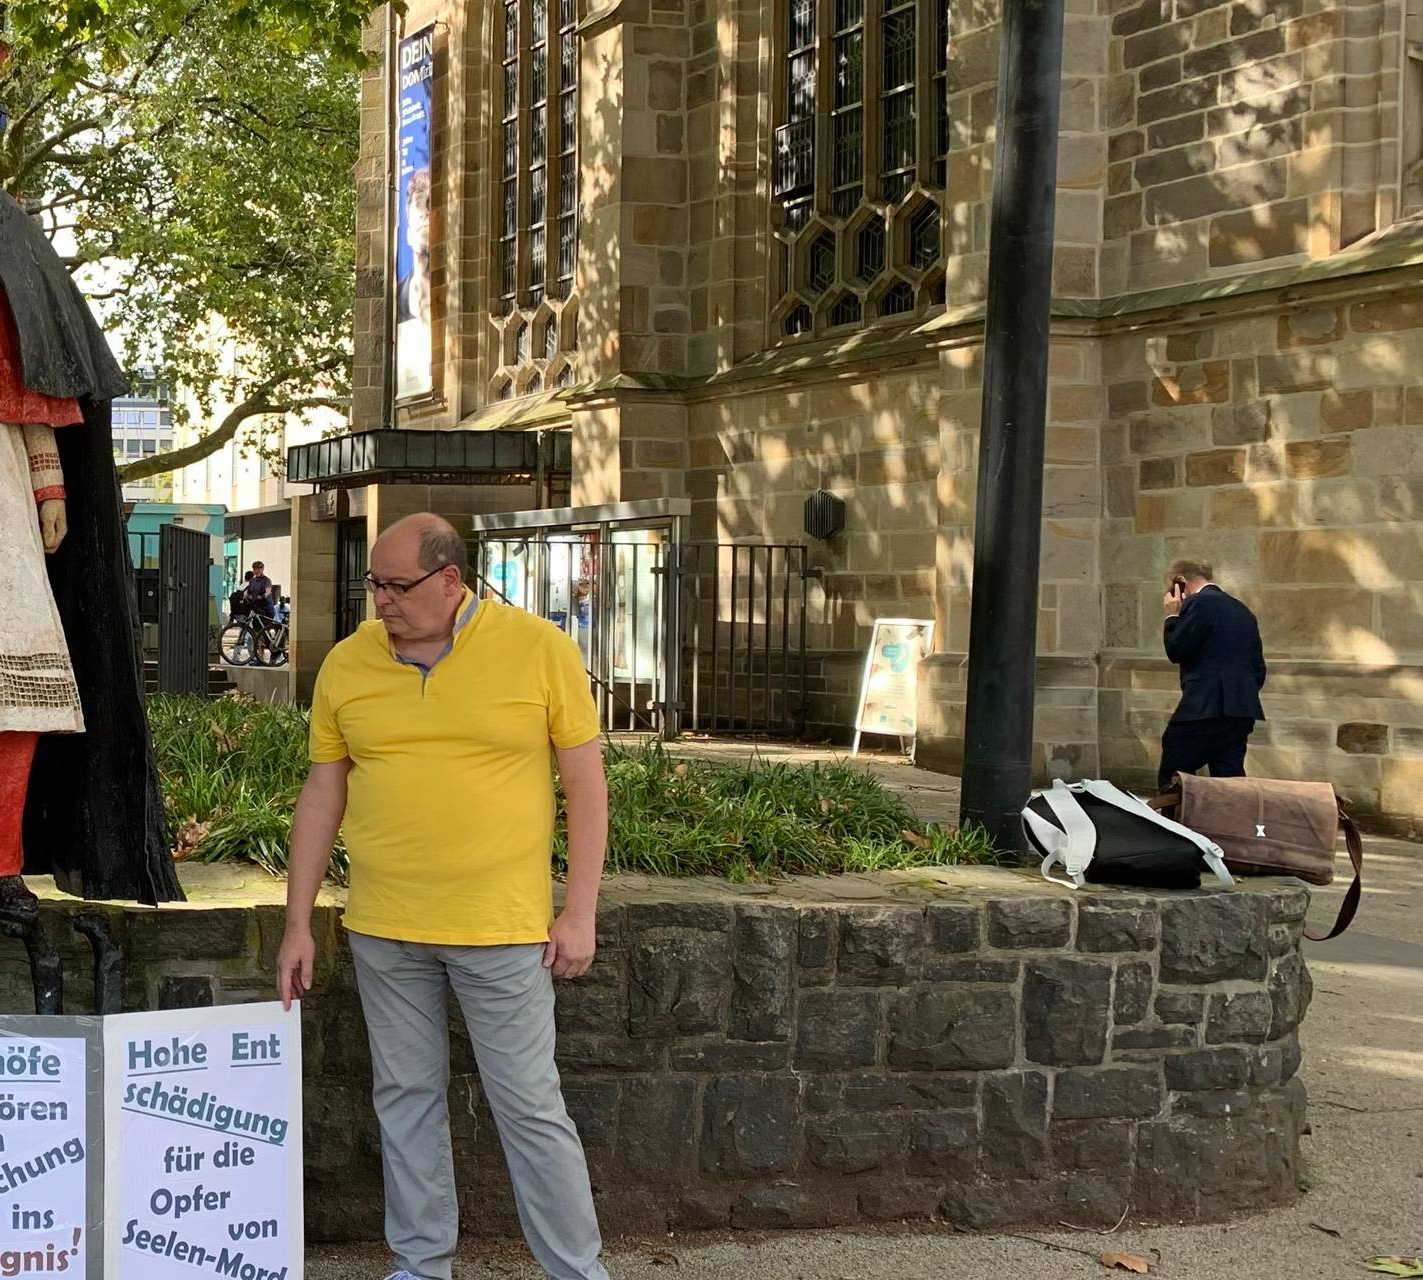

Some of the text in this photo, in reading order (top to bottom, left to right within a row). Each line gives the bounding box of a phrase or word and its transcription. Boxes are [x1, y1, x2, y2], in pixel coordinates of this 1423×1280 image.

[402, 33, 433, 70] DEIN
[128, 1032, 281, 1070] Hohe Ent
[123, 1081, 289, 1143] schädigung
[163, 1142, 255, 1174] für die
[12, 1203, 55, 1230] ins
[150, 1184, 231, 1218] Opfer
[228, 1218, 278, 1241] von
[122, 1219, 288, 1280] Seelen-Mord
